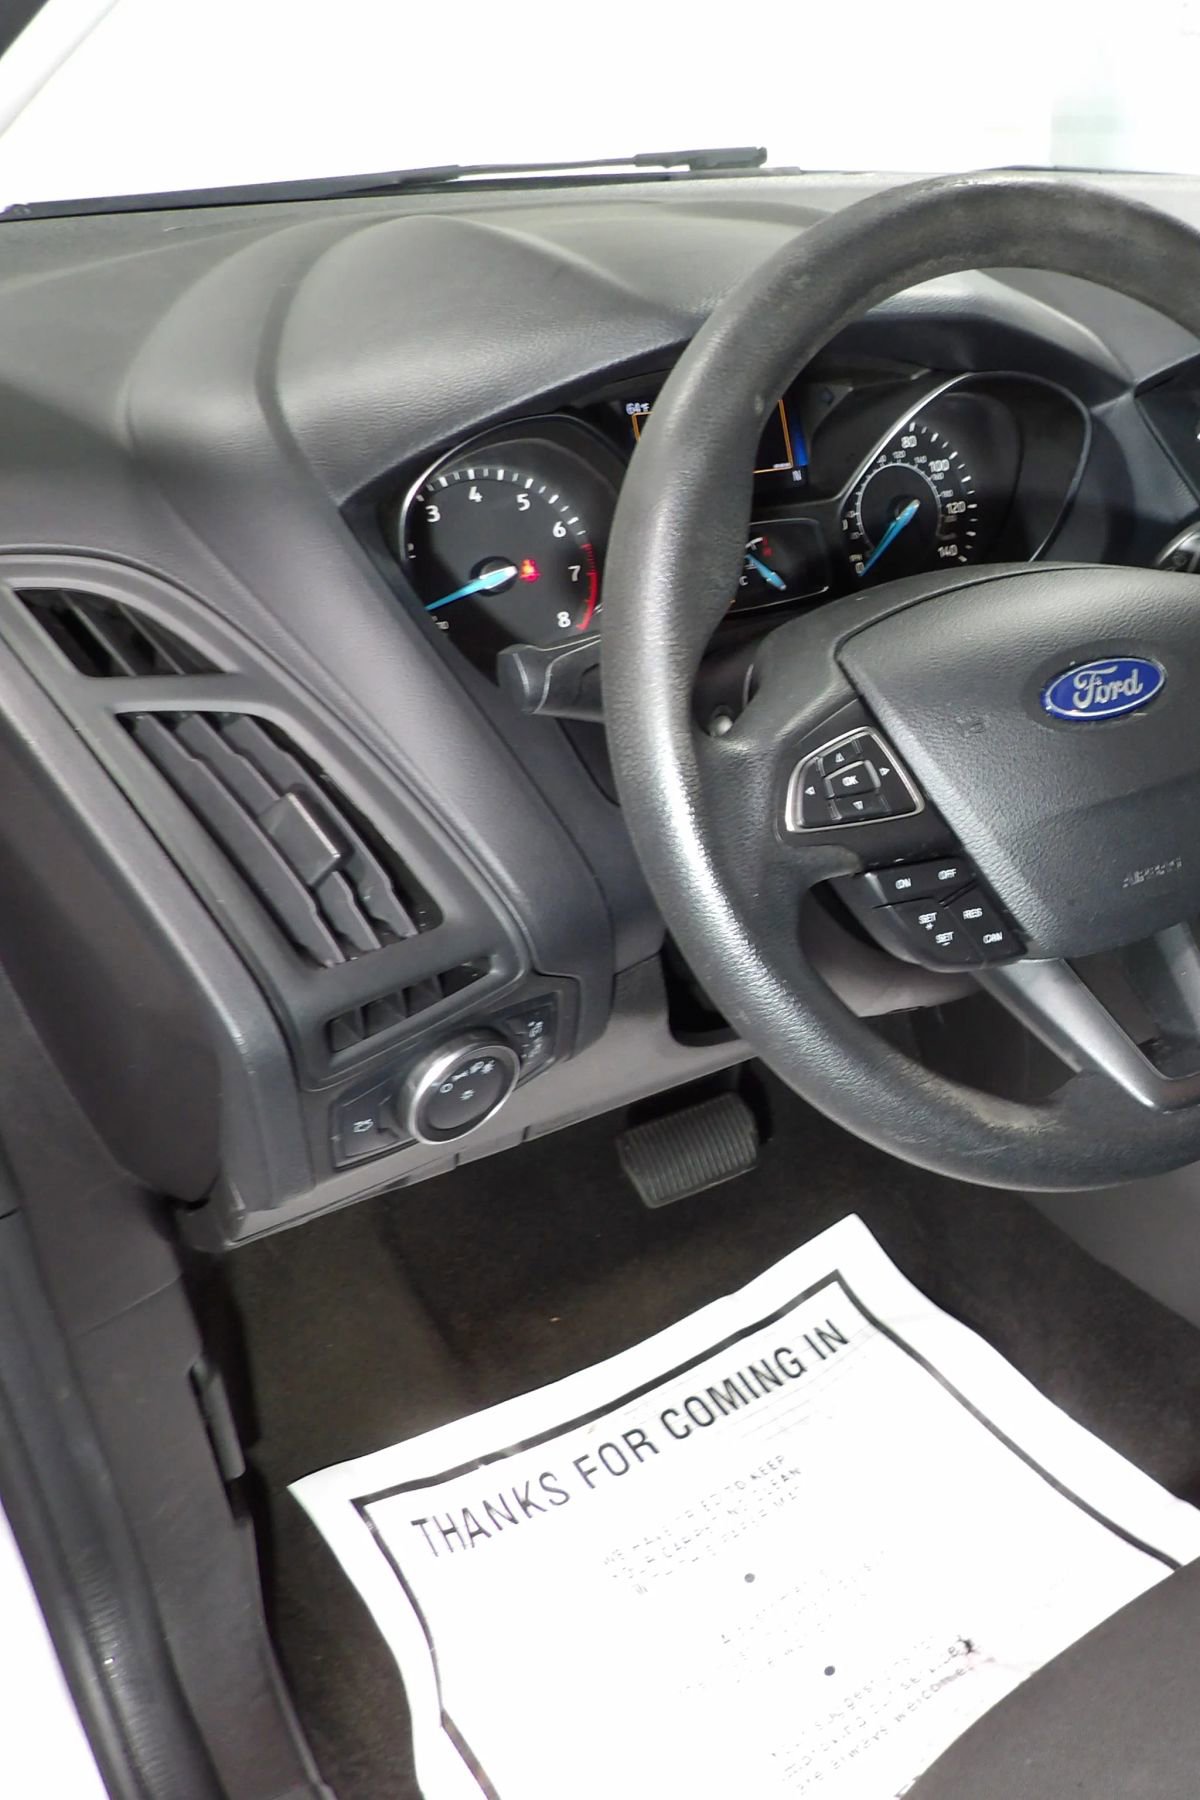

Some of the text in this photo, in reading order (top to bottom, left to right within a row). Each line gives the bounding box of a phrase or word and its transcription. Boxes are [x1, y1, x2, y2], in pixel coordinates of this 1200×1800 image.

[928, 458, 950, 473] 100
[468, 486, 482, 503] 4
[516, 493, 531, 511] 5
[425, 504, 441, 523] 3
[946, 501, 966, 514] 120
[552, 521, 567, 538] 6
[937, 544, 958, 558] 140
[568, 565, 581, 582] 7
[557, 611, 571, 628] 8
[1072, 665, 1143, 709] Ford
[842, 775, 859, 787] OK
[938, 868, 957, 880] OFF
[895, 877, 912, 890] ON
[918, 912, 937, 925] SET
[962, 907, 983, 920] RES
[935, 931, 954, 944] SET
[411, 1472, 570, 1558] THANKS
[572, 1428, 660, 1491] FOR
[659, 1346, 807, 1440] COMING
[802, 1318, 849, 1361] IN
